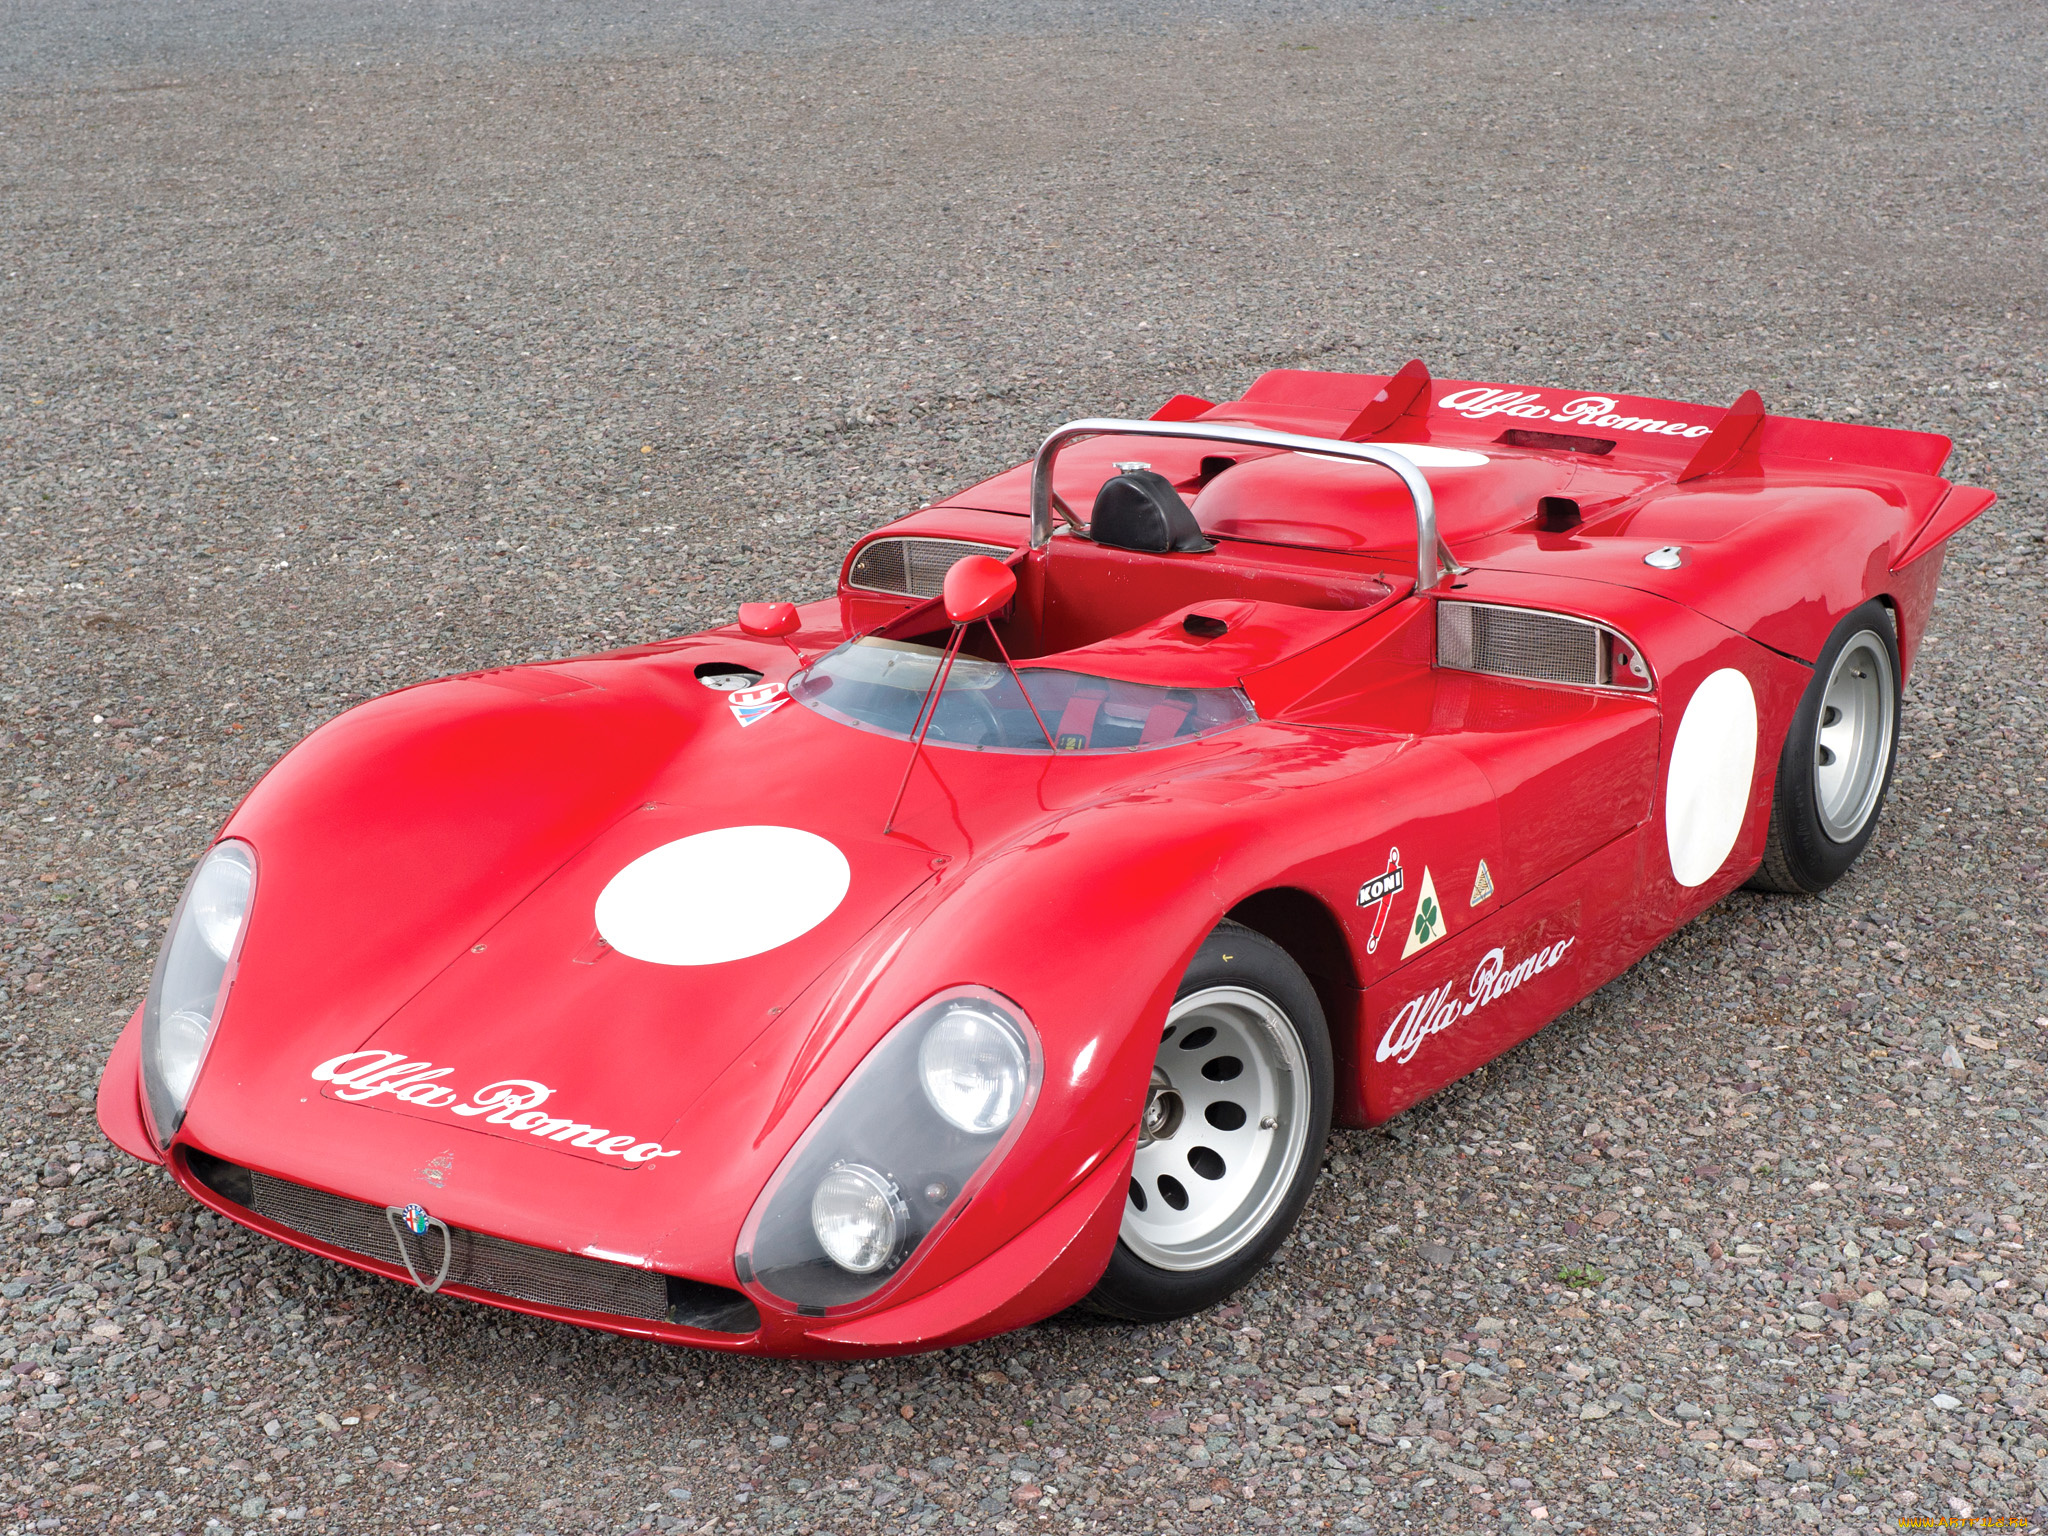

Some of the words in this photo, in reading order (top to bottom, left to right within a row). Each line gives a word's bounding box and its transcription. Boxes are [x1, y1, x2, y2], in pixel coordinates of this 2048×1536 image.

[1438, 387, 1550, 418] Alfa
[1550, 396, 1714, 437] Romeo
[1359, 870, 1401, 904] KONI
[1376, 980, 1461, 1064] Alfa
[1462, 935, 1575, 1016] Romeo
[312, 1050, 456, 1107] Alfa
[451, 1080, 681, 1162] Romeo
